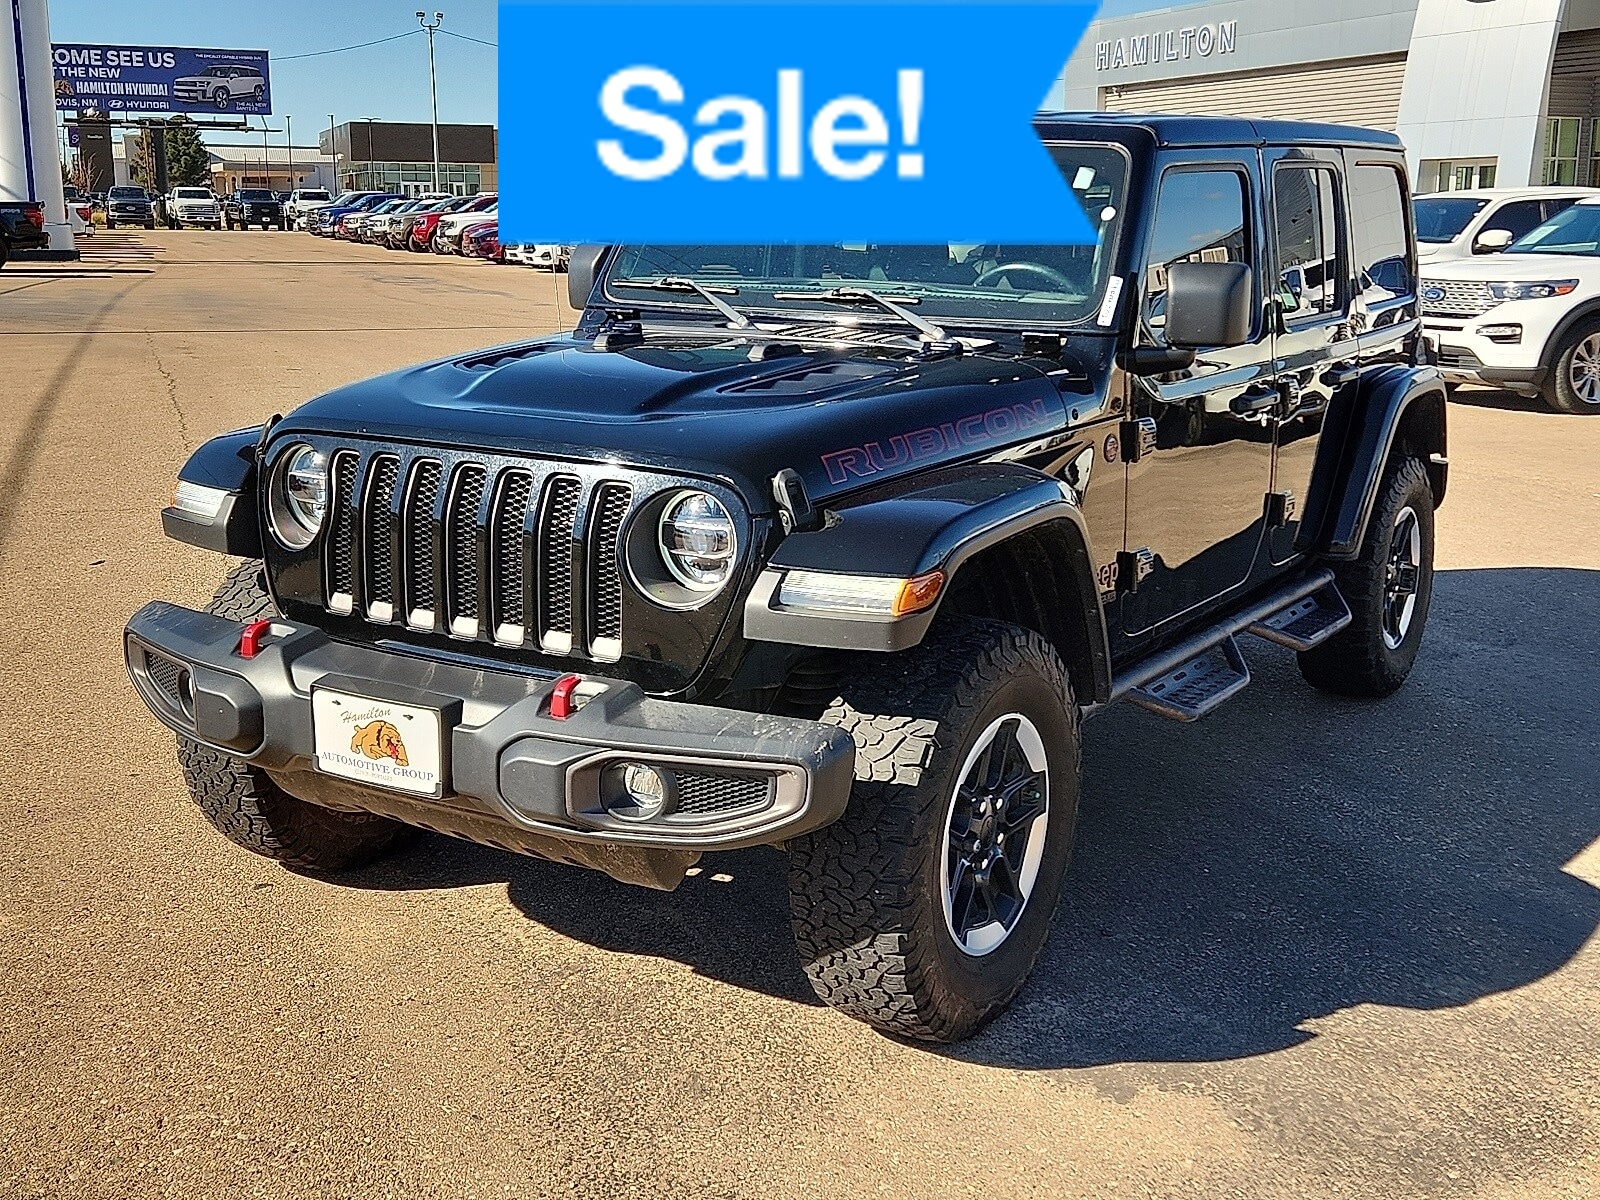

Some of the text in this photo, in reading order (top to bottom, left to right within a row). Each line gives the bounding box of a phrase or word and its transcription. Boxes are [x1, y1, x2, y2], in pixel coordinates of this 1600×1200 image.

[1095, 20, 1237, 71] HAMILTON
[51, 48, 176, 68] OME SEE US
[59, 67, 87, 77] THE
[88, 68, 121, 78] NEW
[76, 81, 169, 96] HAMILTON HYUNDAI
[55, 98, 98, 107] OVIS, NM
[126, 100, 169, 109] HYUNDAI
[821, 399, 1050, 485] RUBICON
[1096, 561, 1118, 588] ep
[340, 706, 392, 724] Hamilton
[321, 751, 390, 774] AUTOMOTIVE
[392, 767, 434, 781] GROUP
